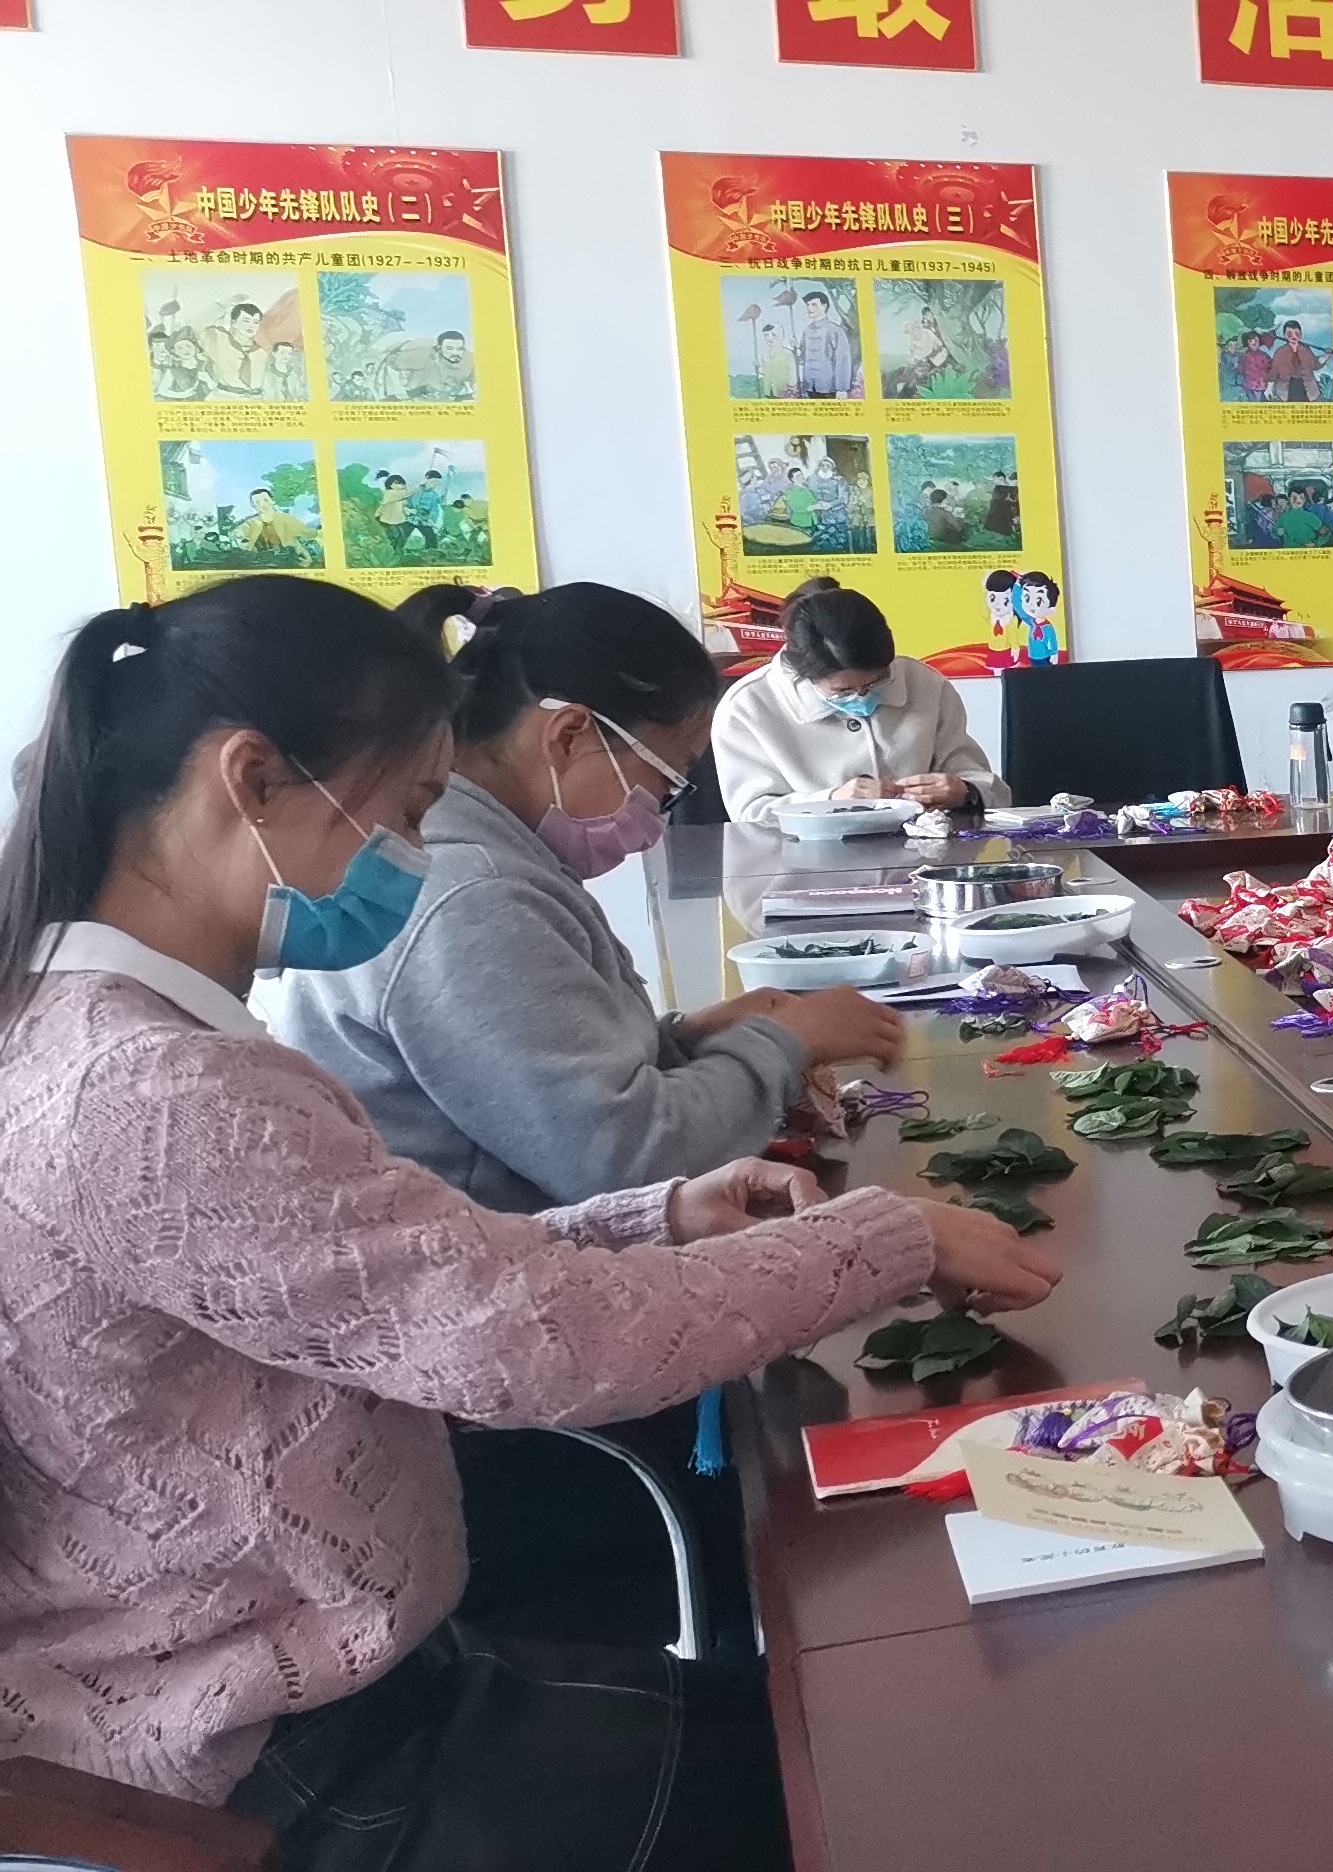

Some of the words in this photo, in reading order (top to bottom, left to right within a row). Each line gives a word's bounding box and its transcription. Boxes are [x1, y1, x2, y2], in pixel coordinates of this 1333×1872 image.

[196, 185, 434, 224] 中国少年先锋队队史（二）
[769, 199, 975, 235] 中国少年先锋队队史（三）
